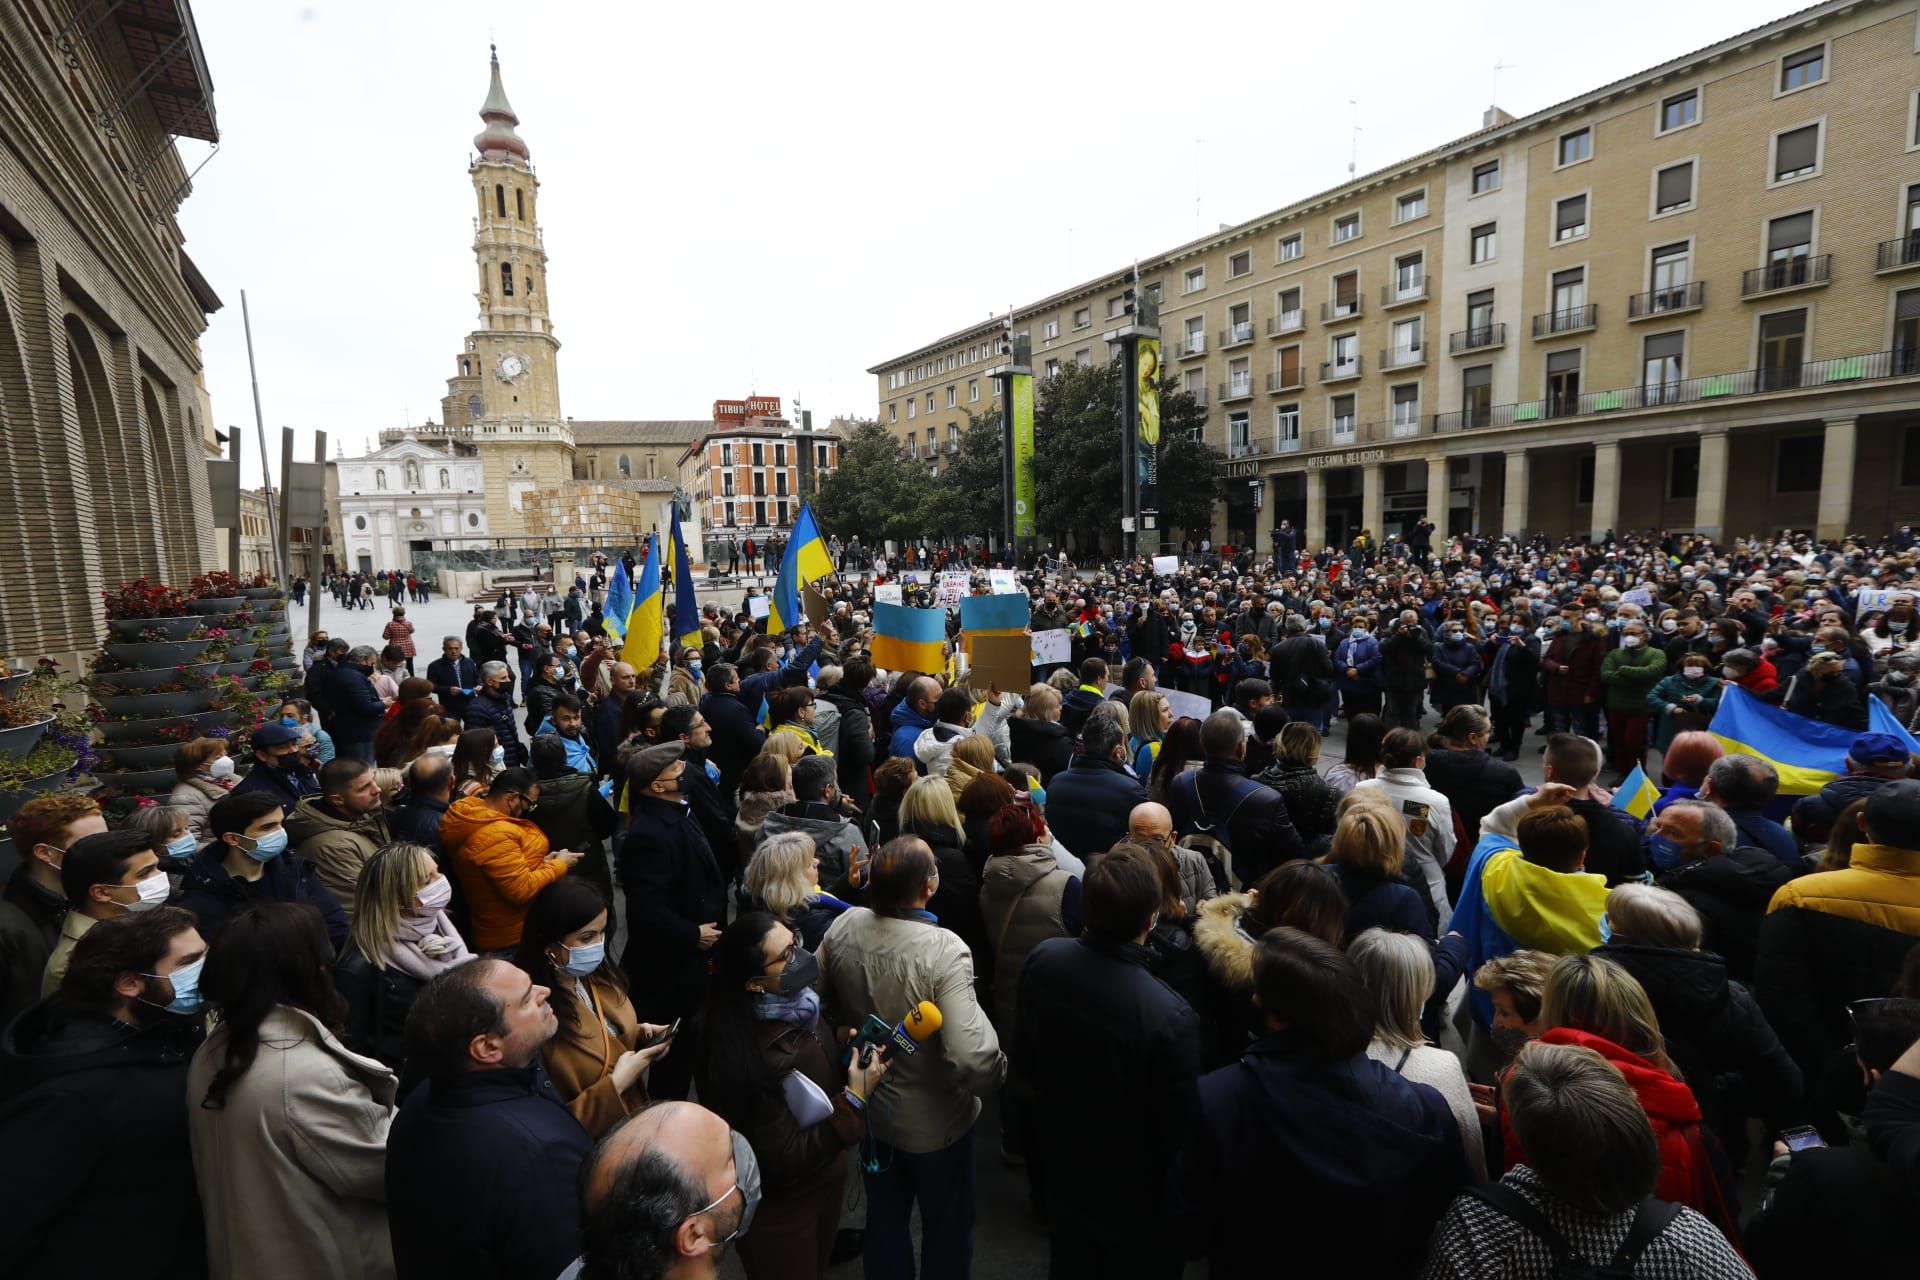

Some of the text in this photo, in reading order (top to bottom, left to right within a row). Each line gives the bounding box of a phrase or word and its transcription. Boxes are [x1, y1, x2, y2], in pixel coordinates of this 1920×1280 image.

[718, 404, 745, 415] TIBUR
[750, 401, 781, 411] HOTEL
[1346, 450, 1385, 465] RELIGIOSA
